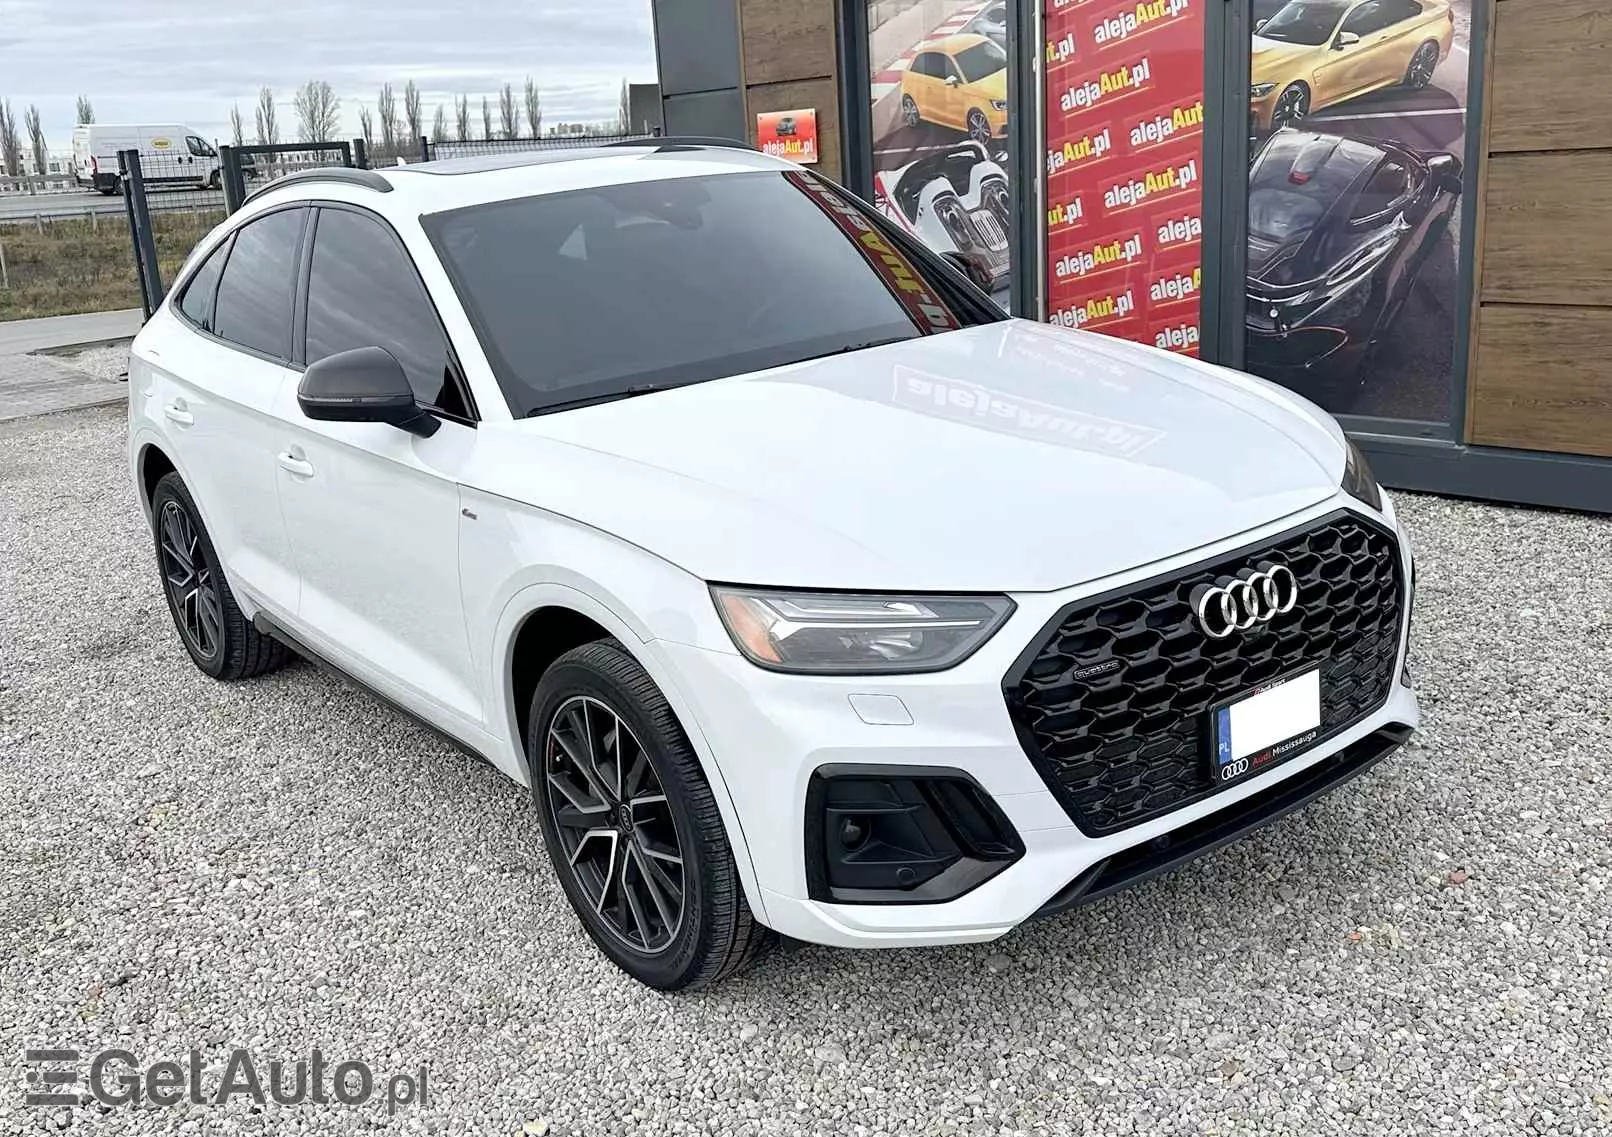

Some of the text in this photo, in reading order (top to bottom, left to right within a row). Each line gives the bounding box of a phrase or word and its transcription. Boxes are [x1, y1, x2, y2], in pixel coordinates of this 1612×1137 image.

[1061, 58, 1150, 111] alejaAut.pl
[762, 137, 814, 156] alejaAut.pl
[1047, 128, 1112, 173] jaAut.pl
[1104, 159, 1197, 209] alejaAut.pl
[1055, 234, 1142, 278] alejaAut.pl
[1050, 289, 1135, 329] alejaAut.pl
[1219, 742, 1230, 755] PL
[1251, 730, 1317, 769] Audi Mississauga
